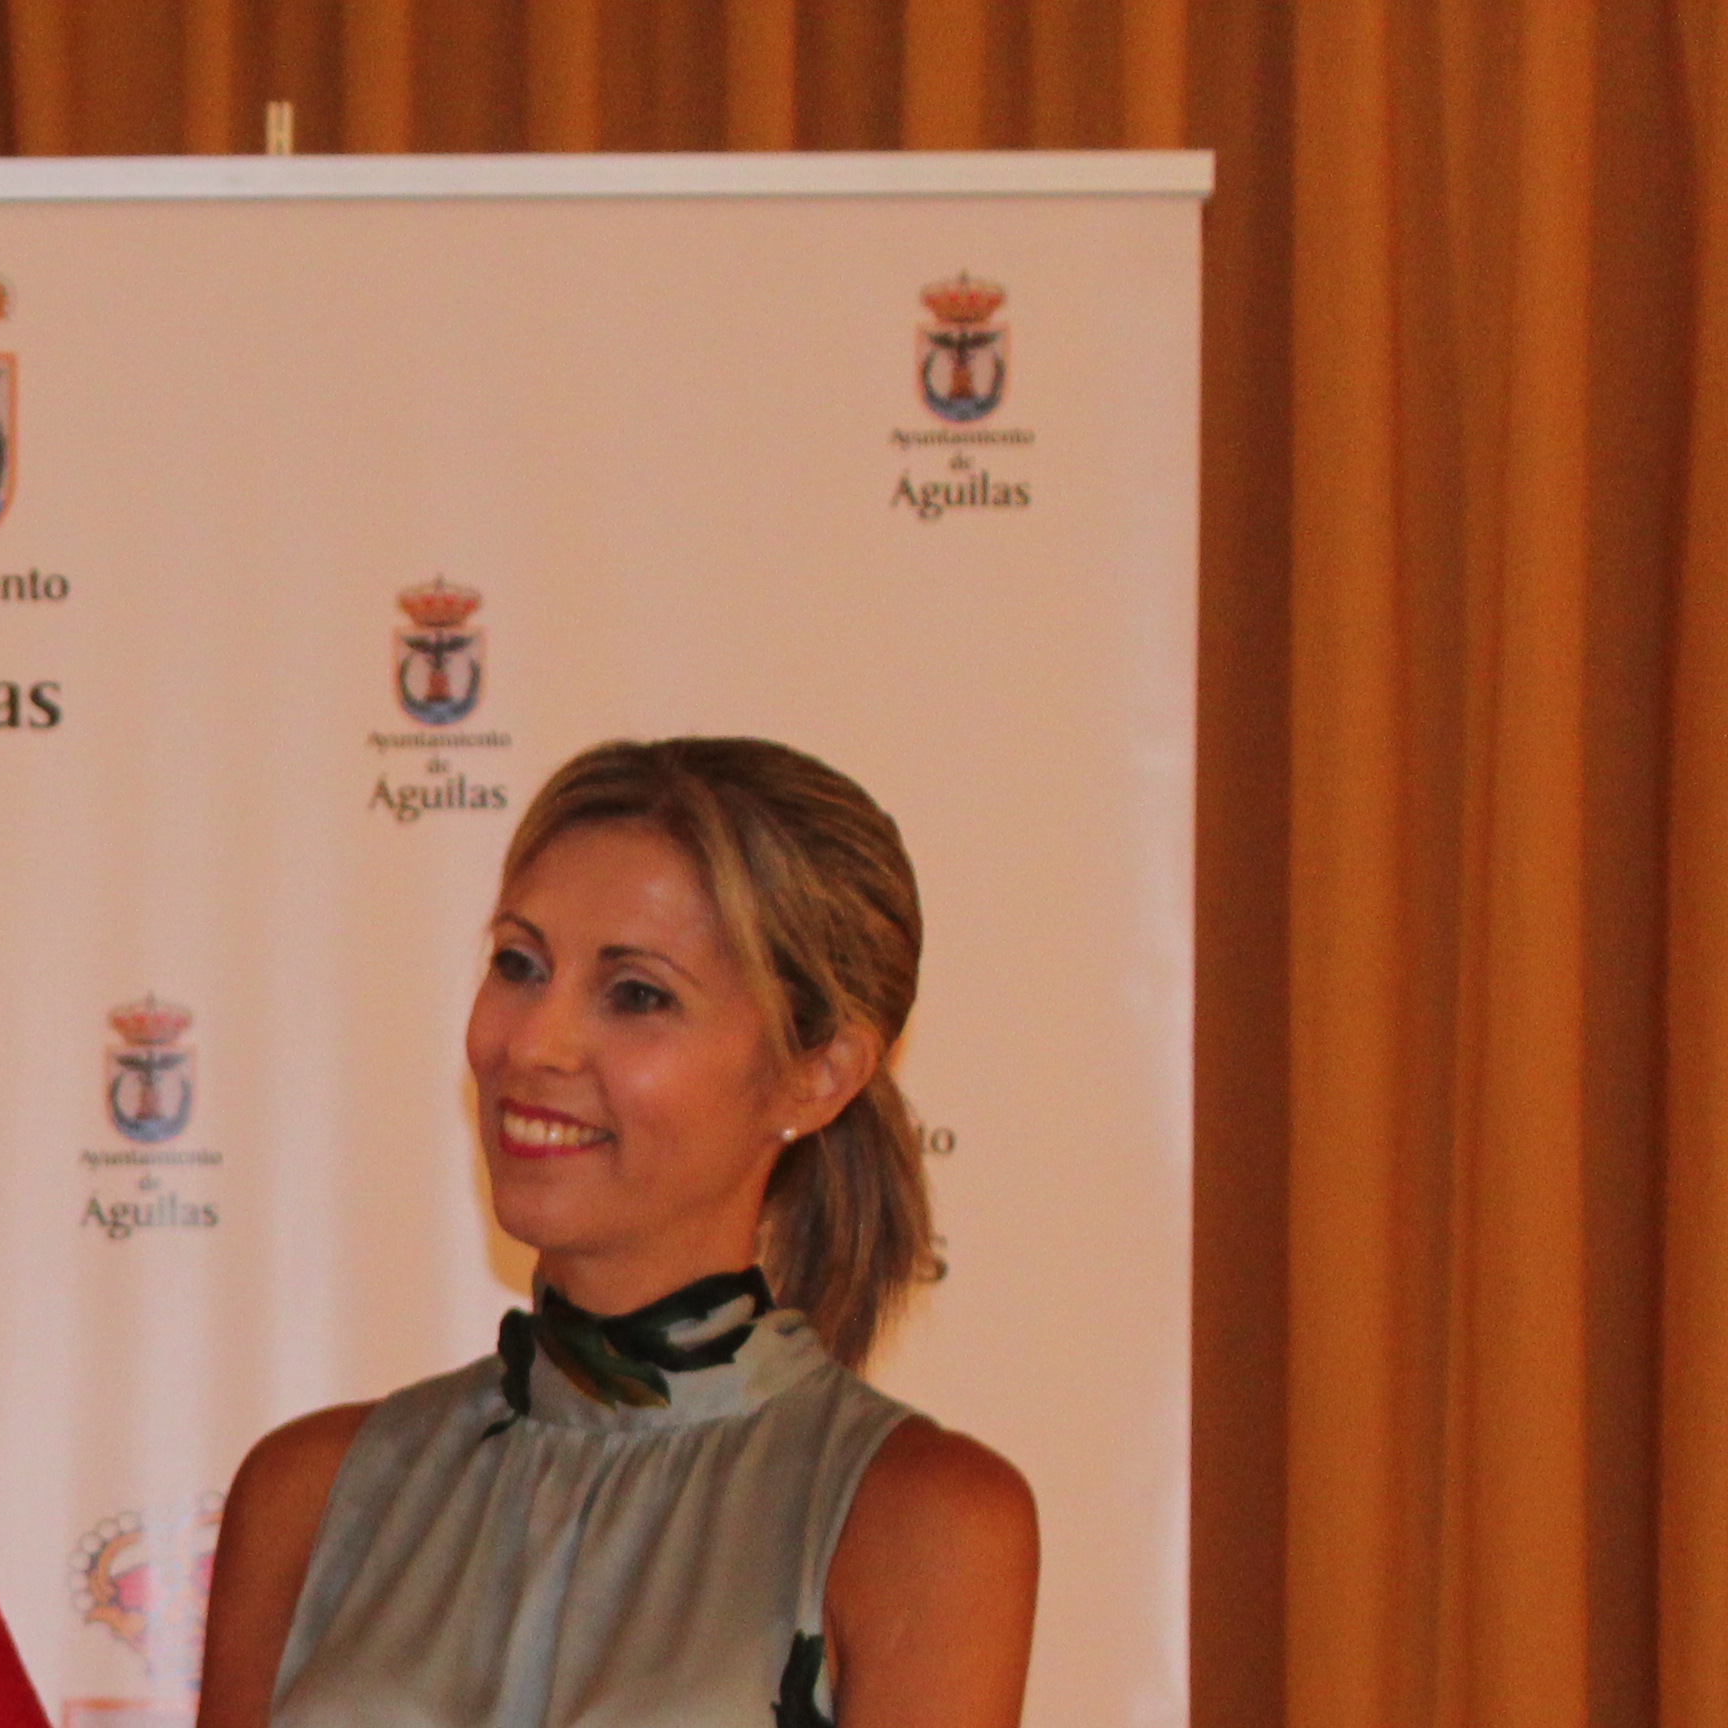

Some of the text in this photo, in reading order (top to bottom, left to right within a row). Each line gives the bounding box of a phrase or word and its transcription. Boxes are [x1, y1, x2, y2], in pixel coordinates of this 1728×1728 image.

[889, 426, 1035, 449] Ayuntamiento
[948, 451, 971, 470] de
[890, 468, 1031, 520] Águilas
[366, 729, 512, 753] Ayuntamiento
[427, 755, 450, 775] de
[367, 774, 507, 823] Águilas
[80, 1191, 218, 1240] Águilas
